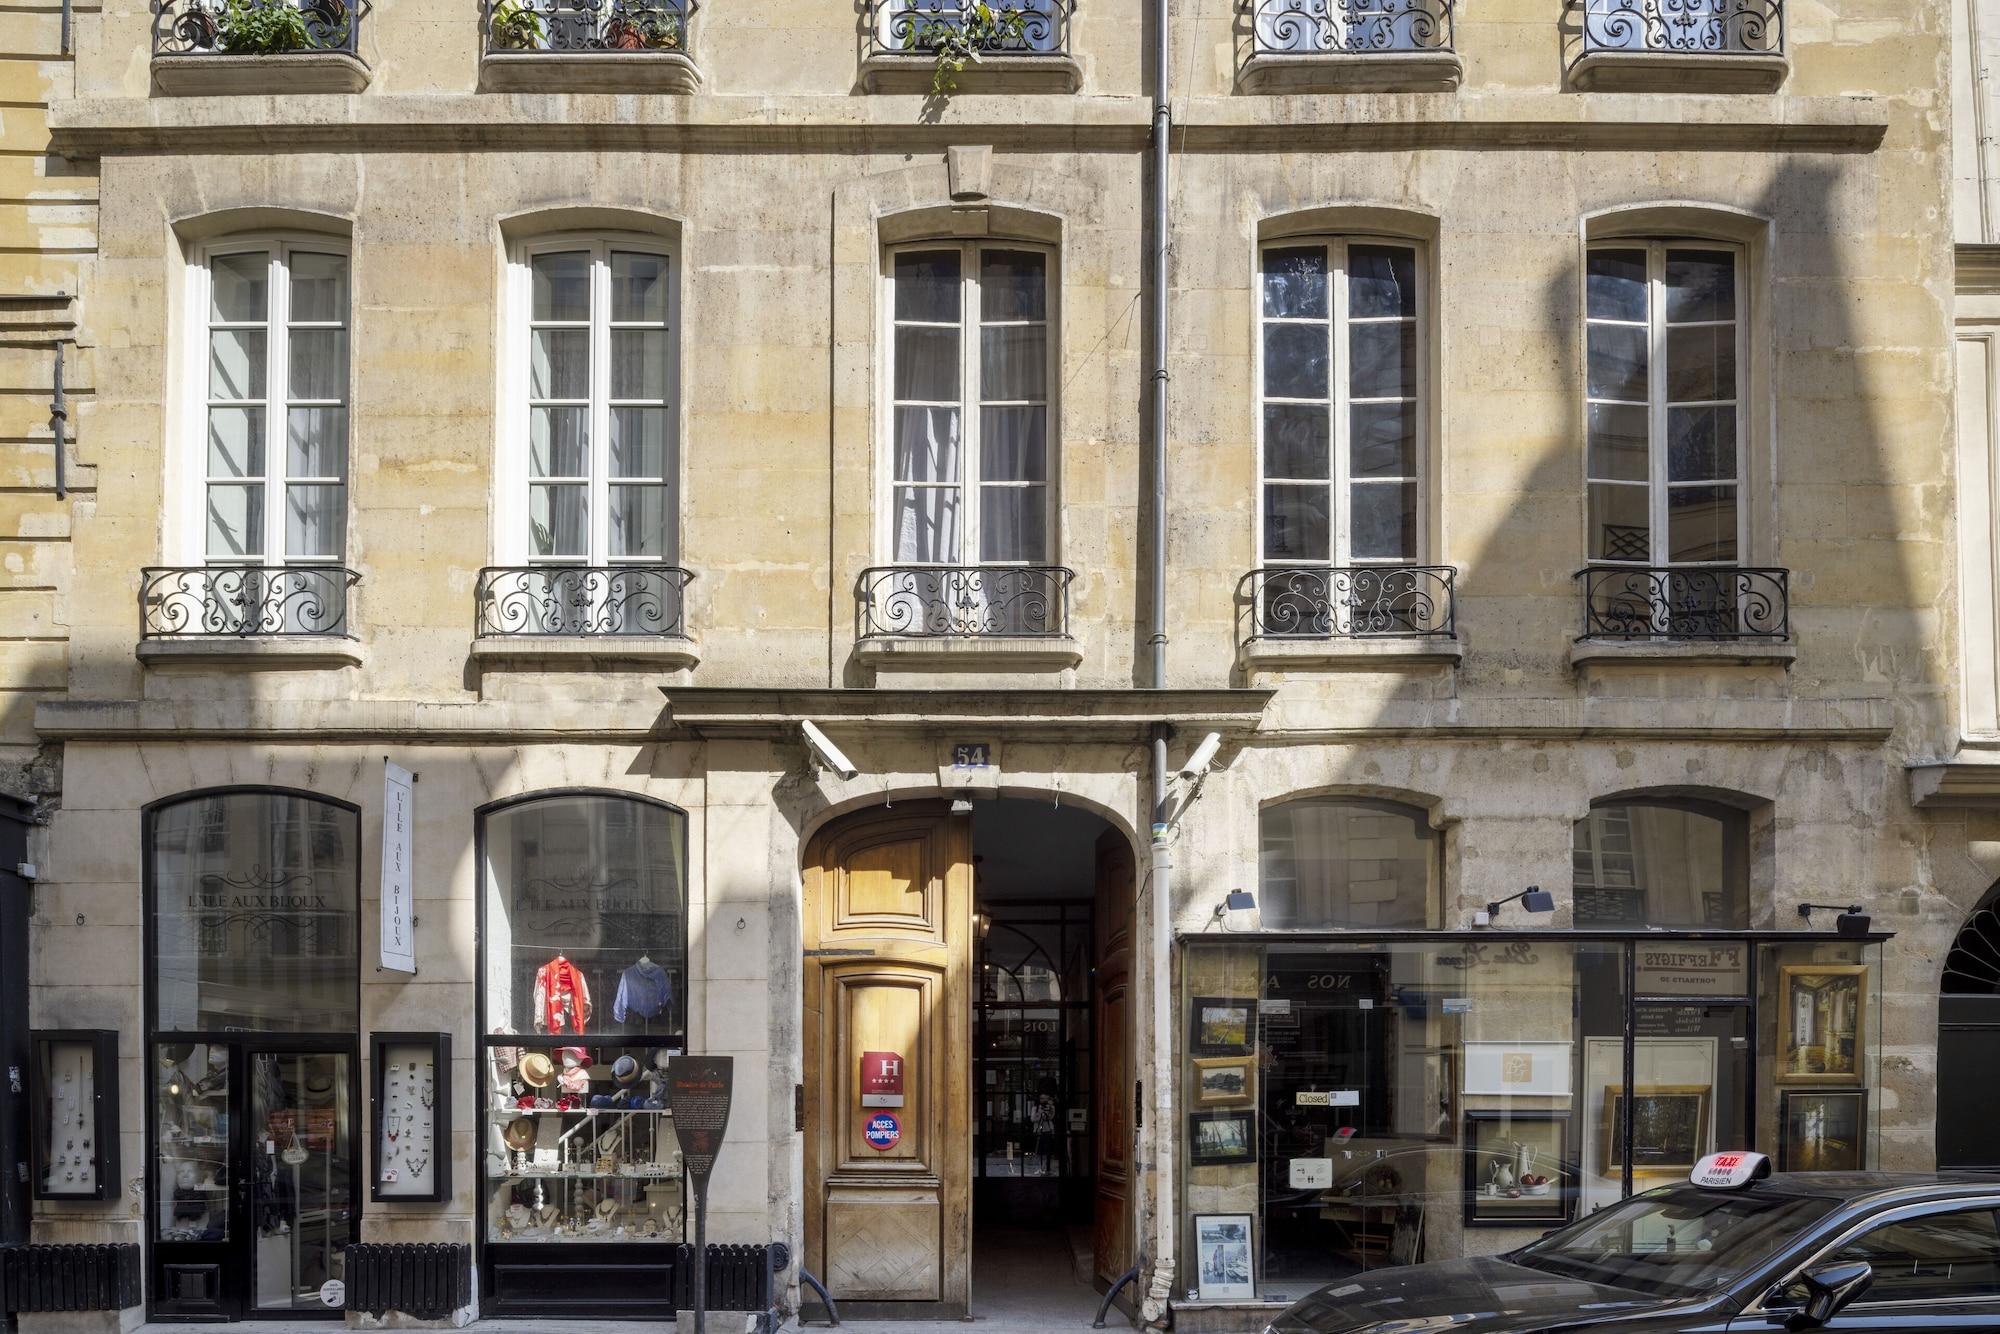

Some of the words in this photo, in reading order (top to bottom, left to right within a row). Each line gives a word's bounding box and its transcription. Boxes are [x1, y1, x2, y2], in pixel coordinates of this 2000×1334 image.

[956, 747, 985, 767] 54
[395, 843, 403, 873] AUX
[232, 895, 266, 908] AUX
[270, 895, 326, 908] BIJOUX
[393, 885, 402, 946] BIJOUX
[880, 1059, 899, 1076] H
[1299, 1094, 1328, 1103] Closed
[872, 1120, 893, 1129] ACCES
[866, 1130, 900, 1139] POMPIERS
[1715, 1156, 1740, 1167] TAXI
[1700, 1176, 1732, 1185] PARISIEN
